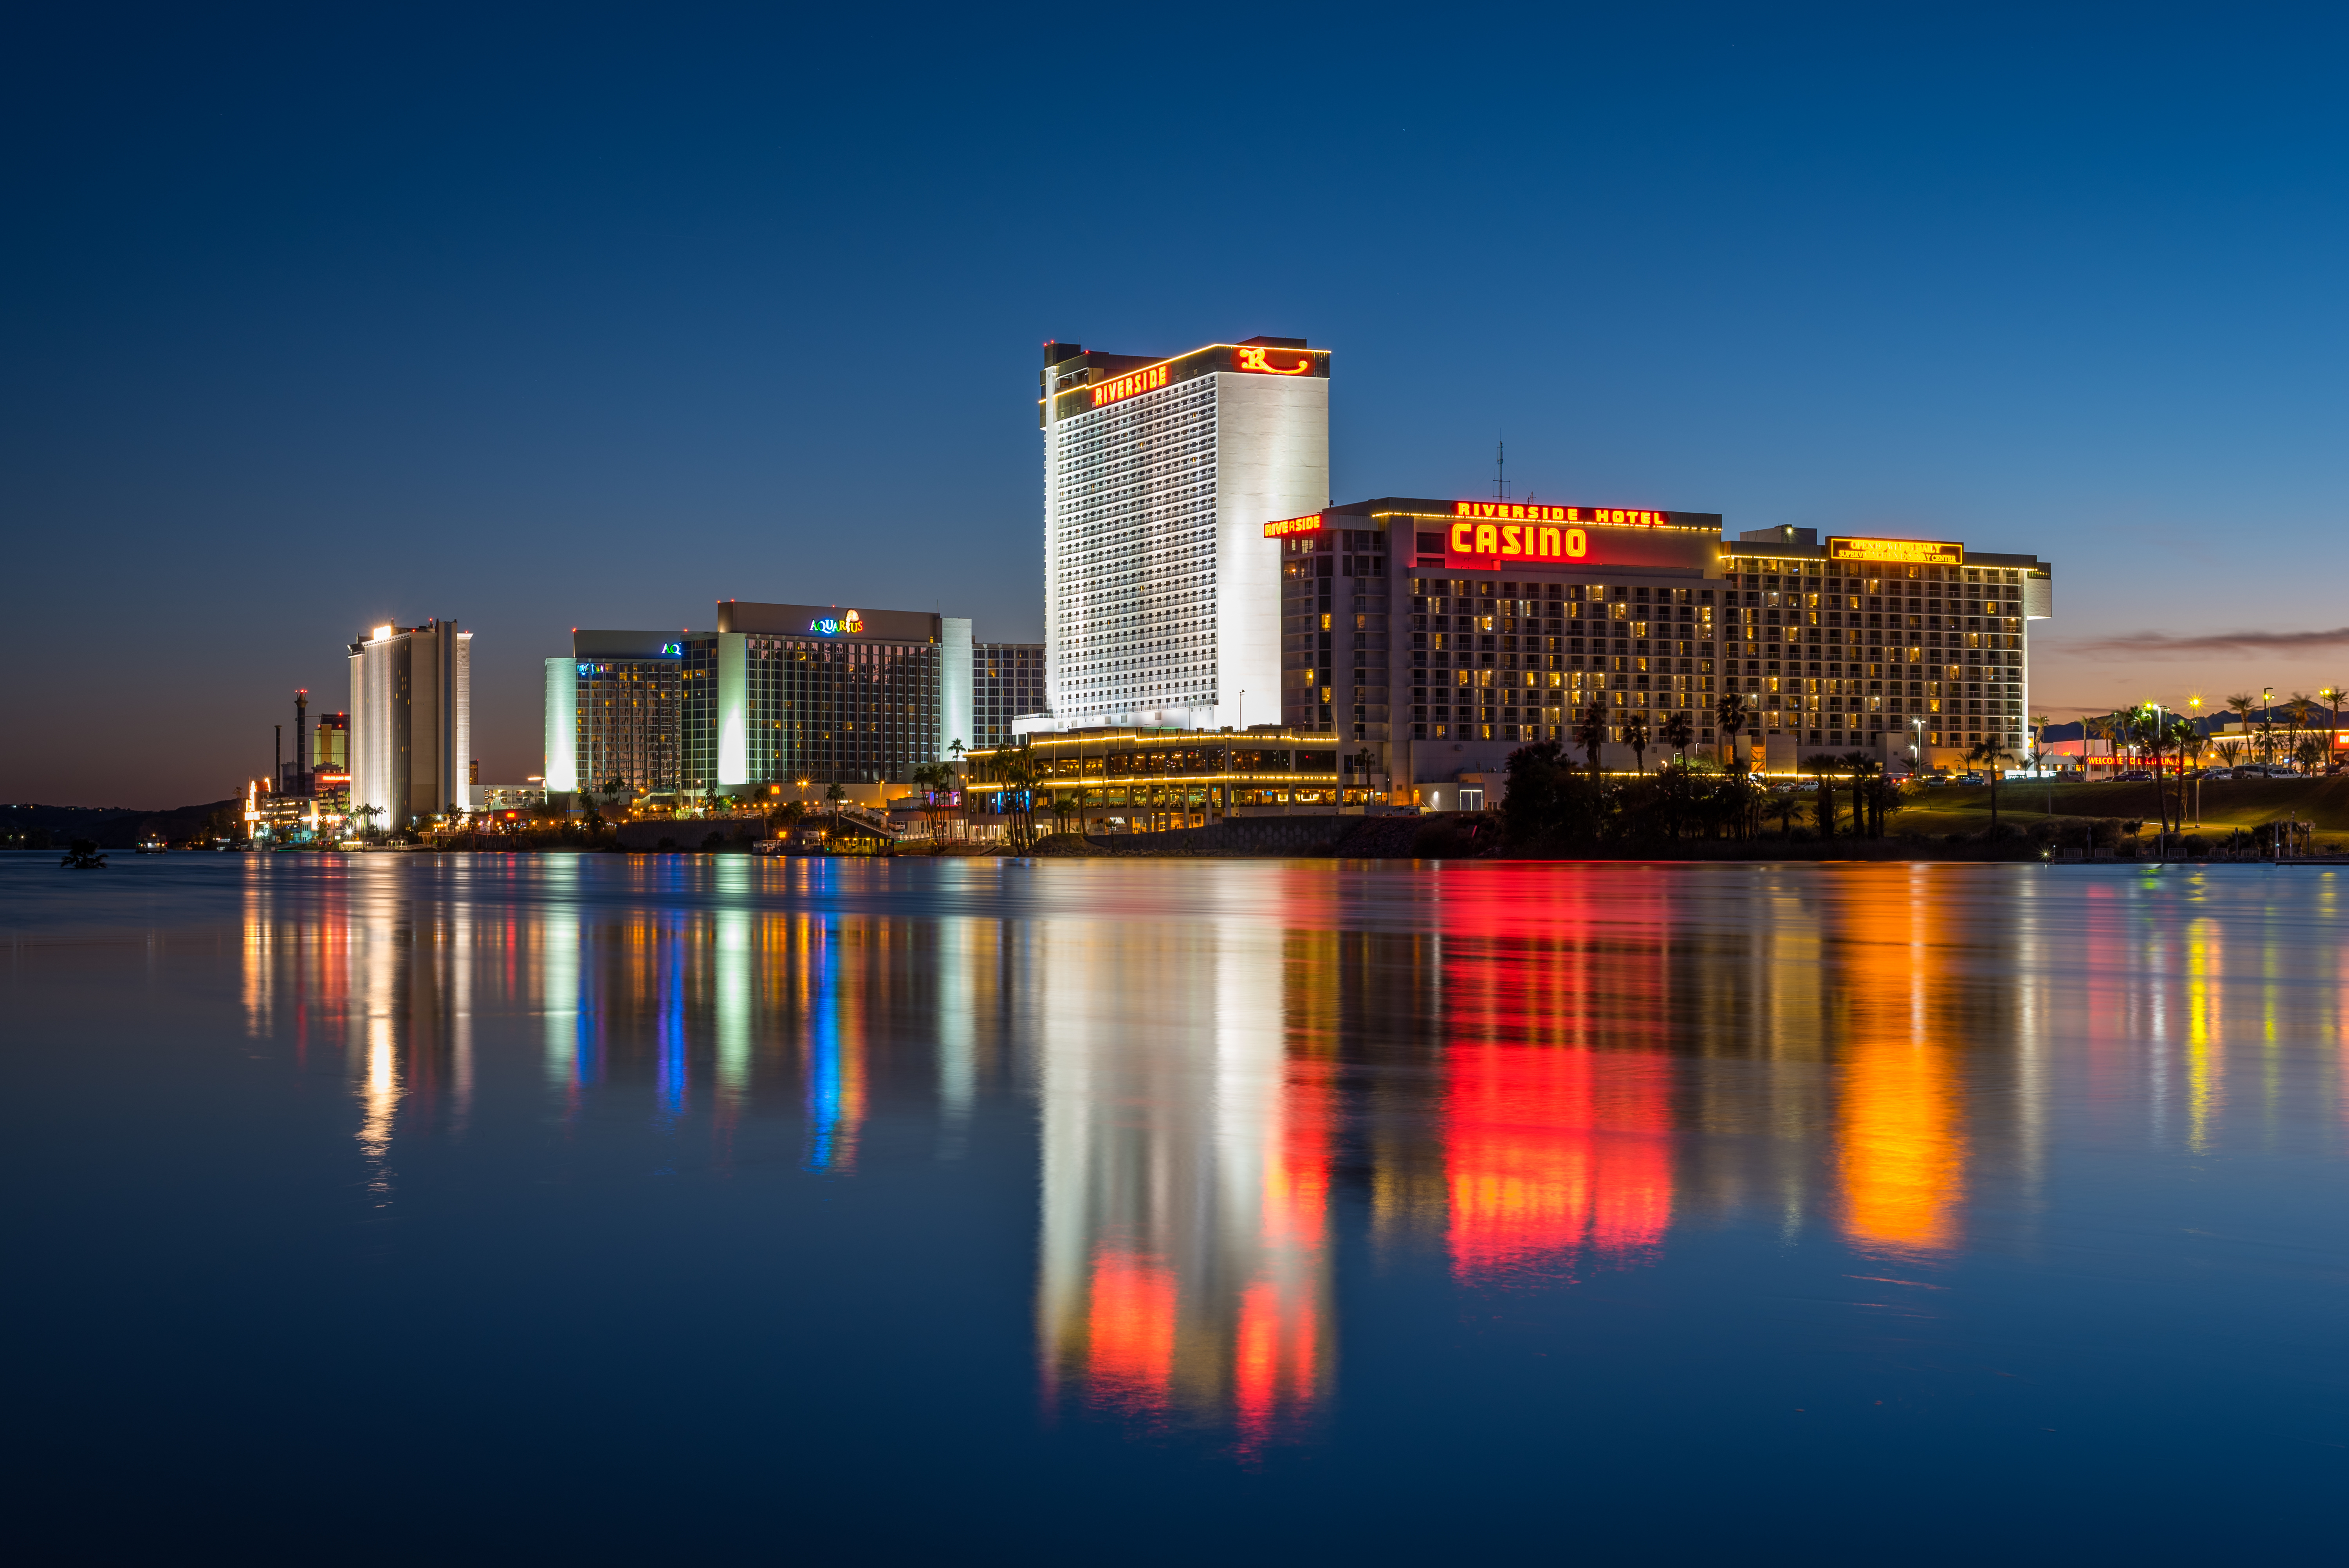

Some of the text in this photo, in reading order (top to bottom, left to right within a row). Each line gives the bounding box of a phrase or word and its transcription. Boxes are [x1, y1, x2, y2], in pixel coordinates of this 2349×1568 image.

[1095, 366, 1166, 406] RIVERSIDE
[1458, 503, 1663, 525] RIVERSIDE HOTEL
[1265, 515, 1320, 536] RIVERSIDE
[1452, 523, 1586, 557] CASINO
[1915, 544, 1941, 554] DAILY
[809, 617, 863, 634] AQUARIUS
[661, 642, 681, 655] AQ
